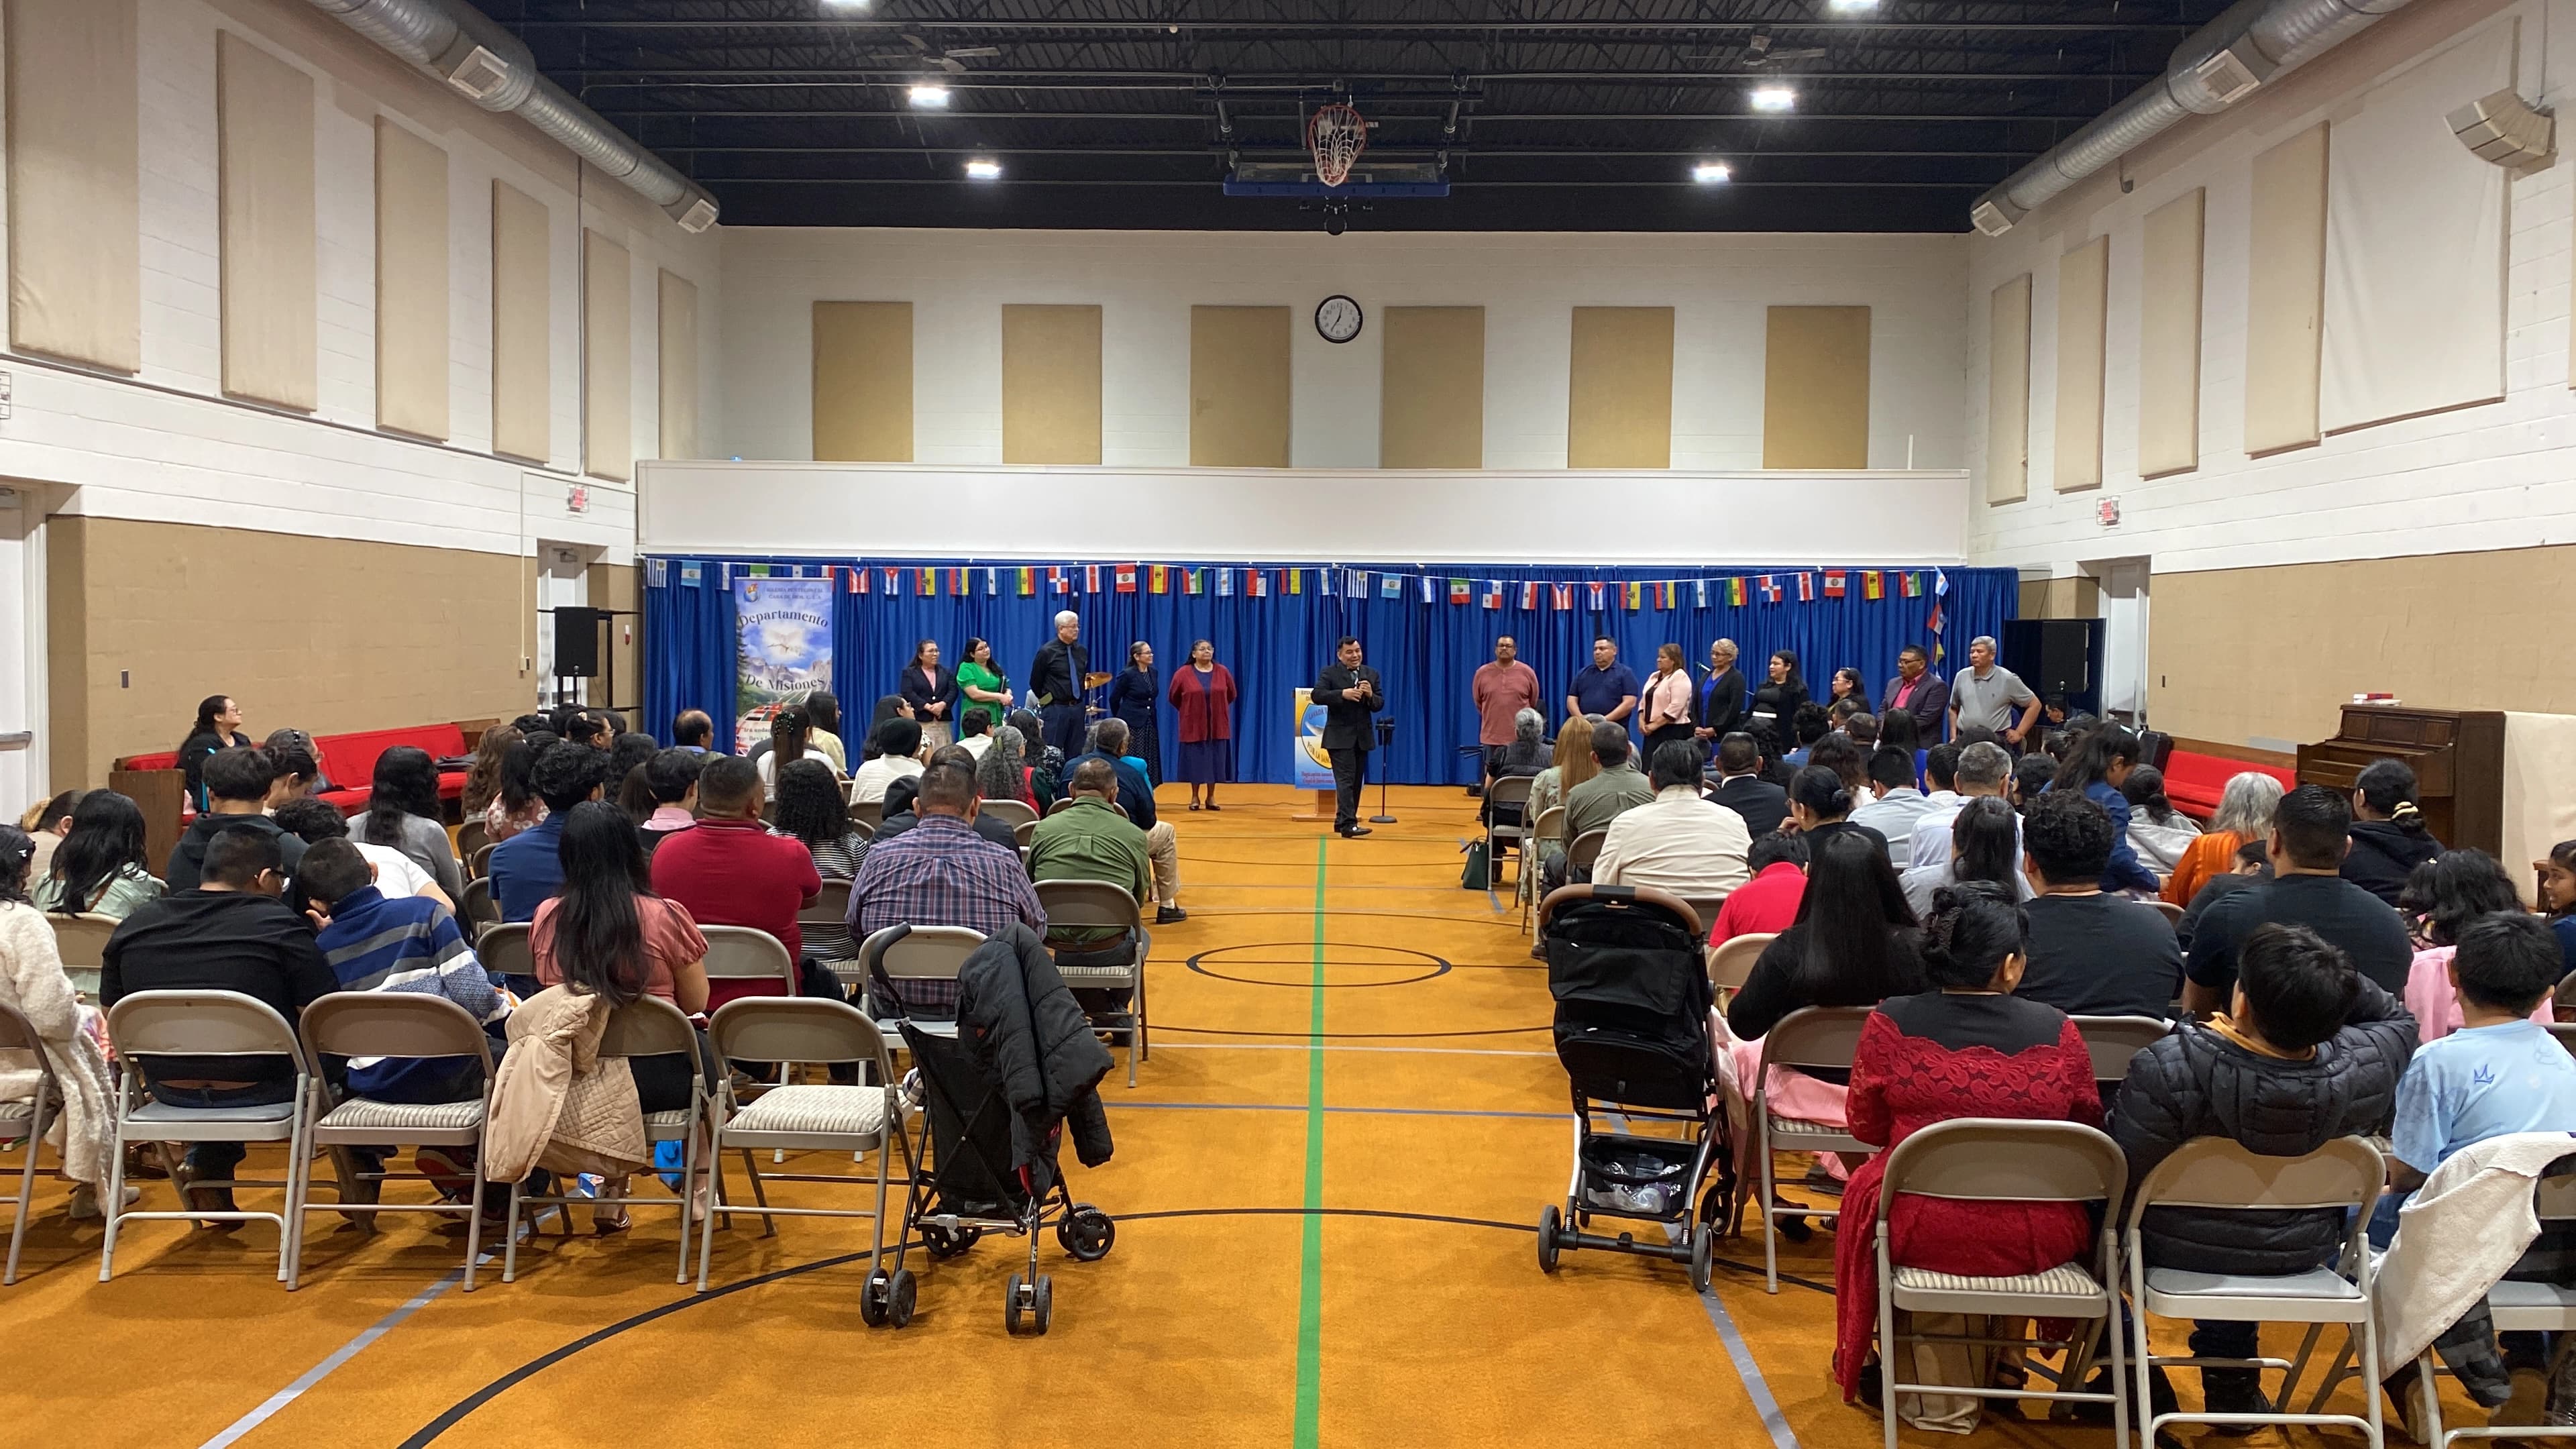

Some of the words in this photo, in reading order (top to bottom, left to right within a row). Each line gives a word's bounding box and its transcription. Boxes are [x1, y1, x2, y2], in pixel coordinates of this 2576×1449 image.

[739, 610, 828, 627] Departamento
[745, 674, 763, 688] De
[767, 678, 824, 691] Misiones
